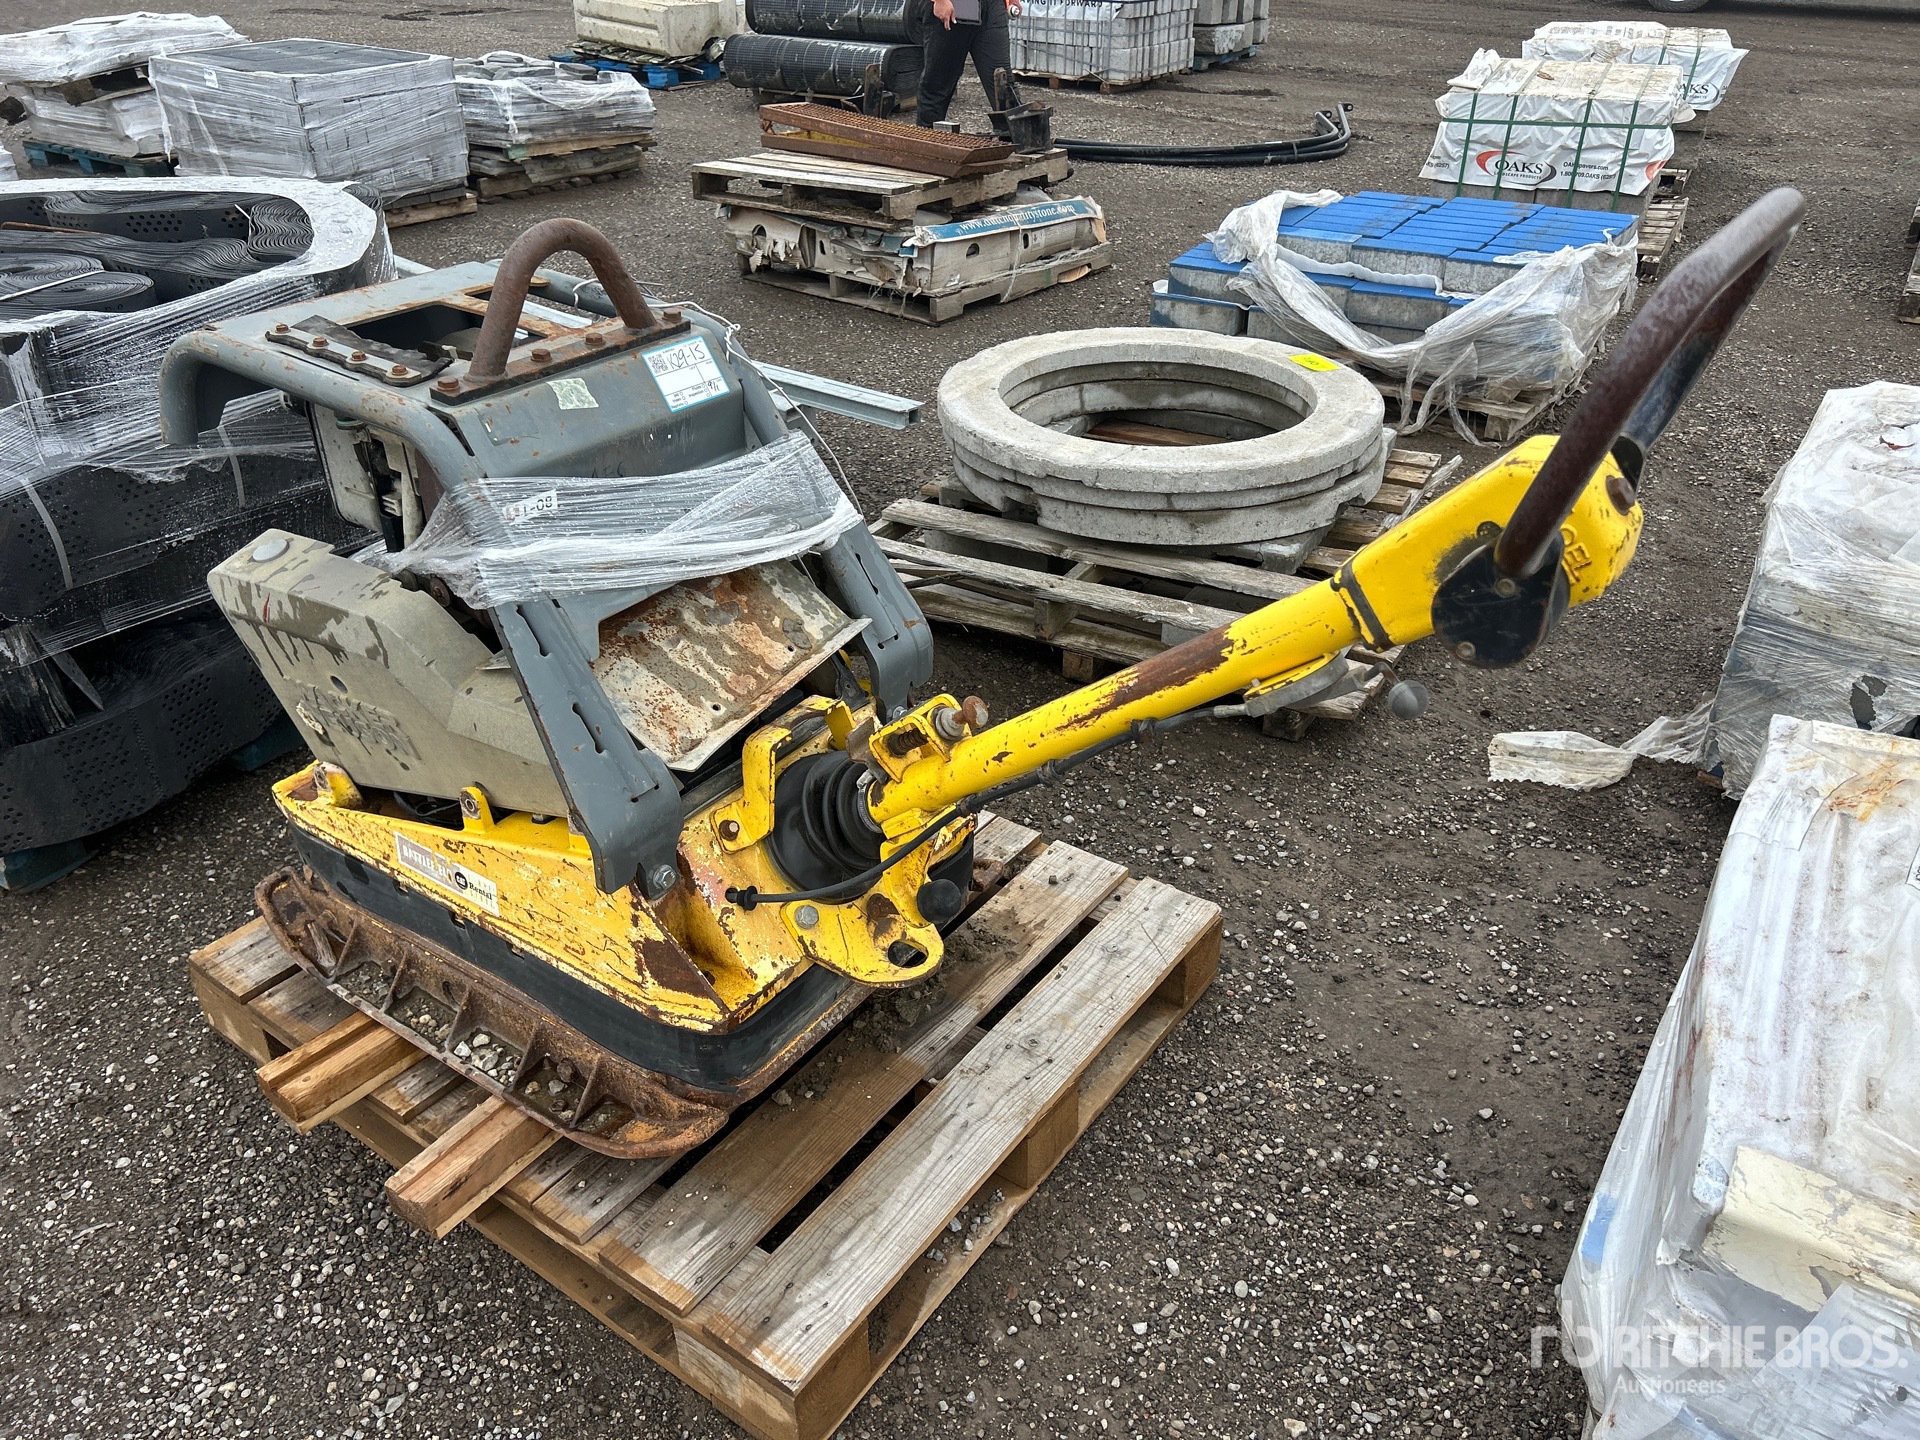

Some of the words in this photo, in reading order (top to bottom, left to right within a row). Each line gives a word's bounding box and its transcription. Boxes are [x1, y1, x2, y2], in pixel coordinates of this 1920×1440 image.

[1679, 83, 1709, 94] AKS
[1494, 159, 1544, 175] OAKS
[1563, 161, 1608, 171] OAKpavers.com
[402, 843, 453, 882] BATTLEFELD
[468, 881, 493, 901] Rental
